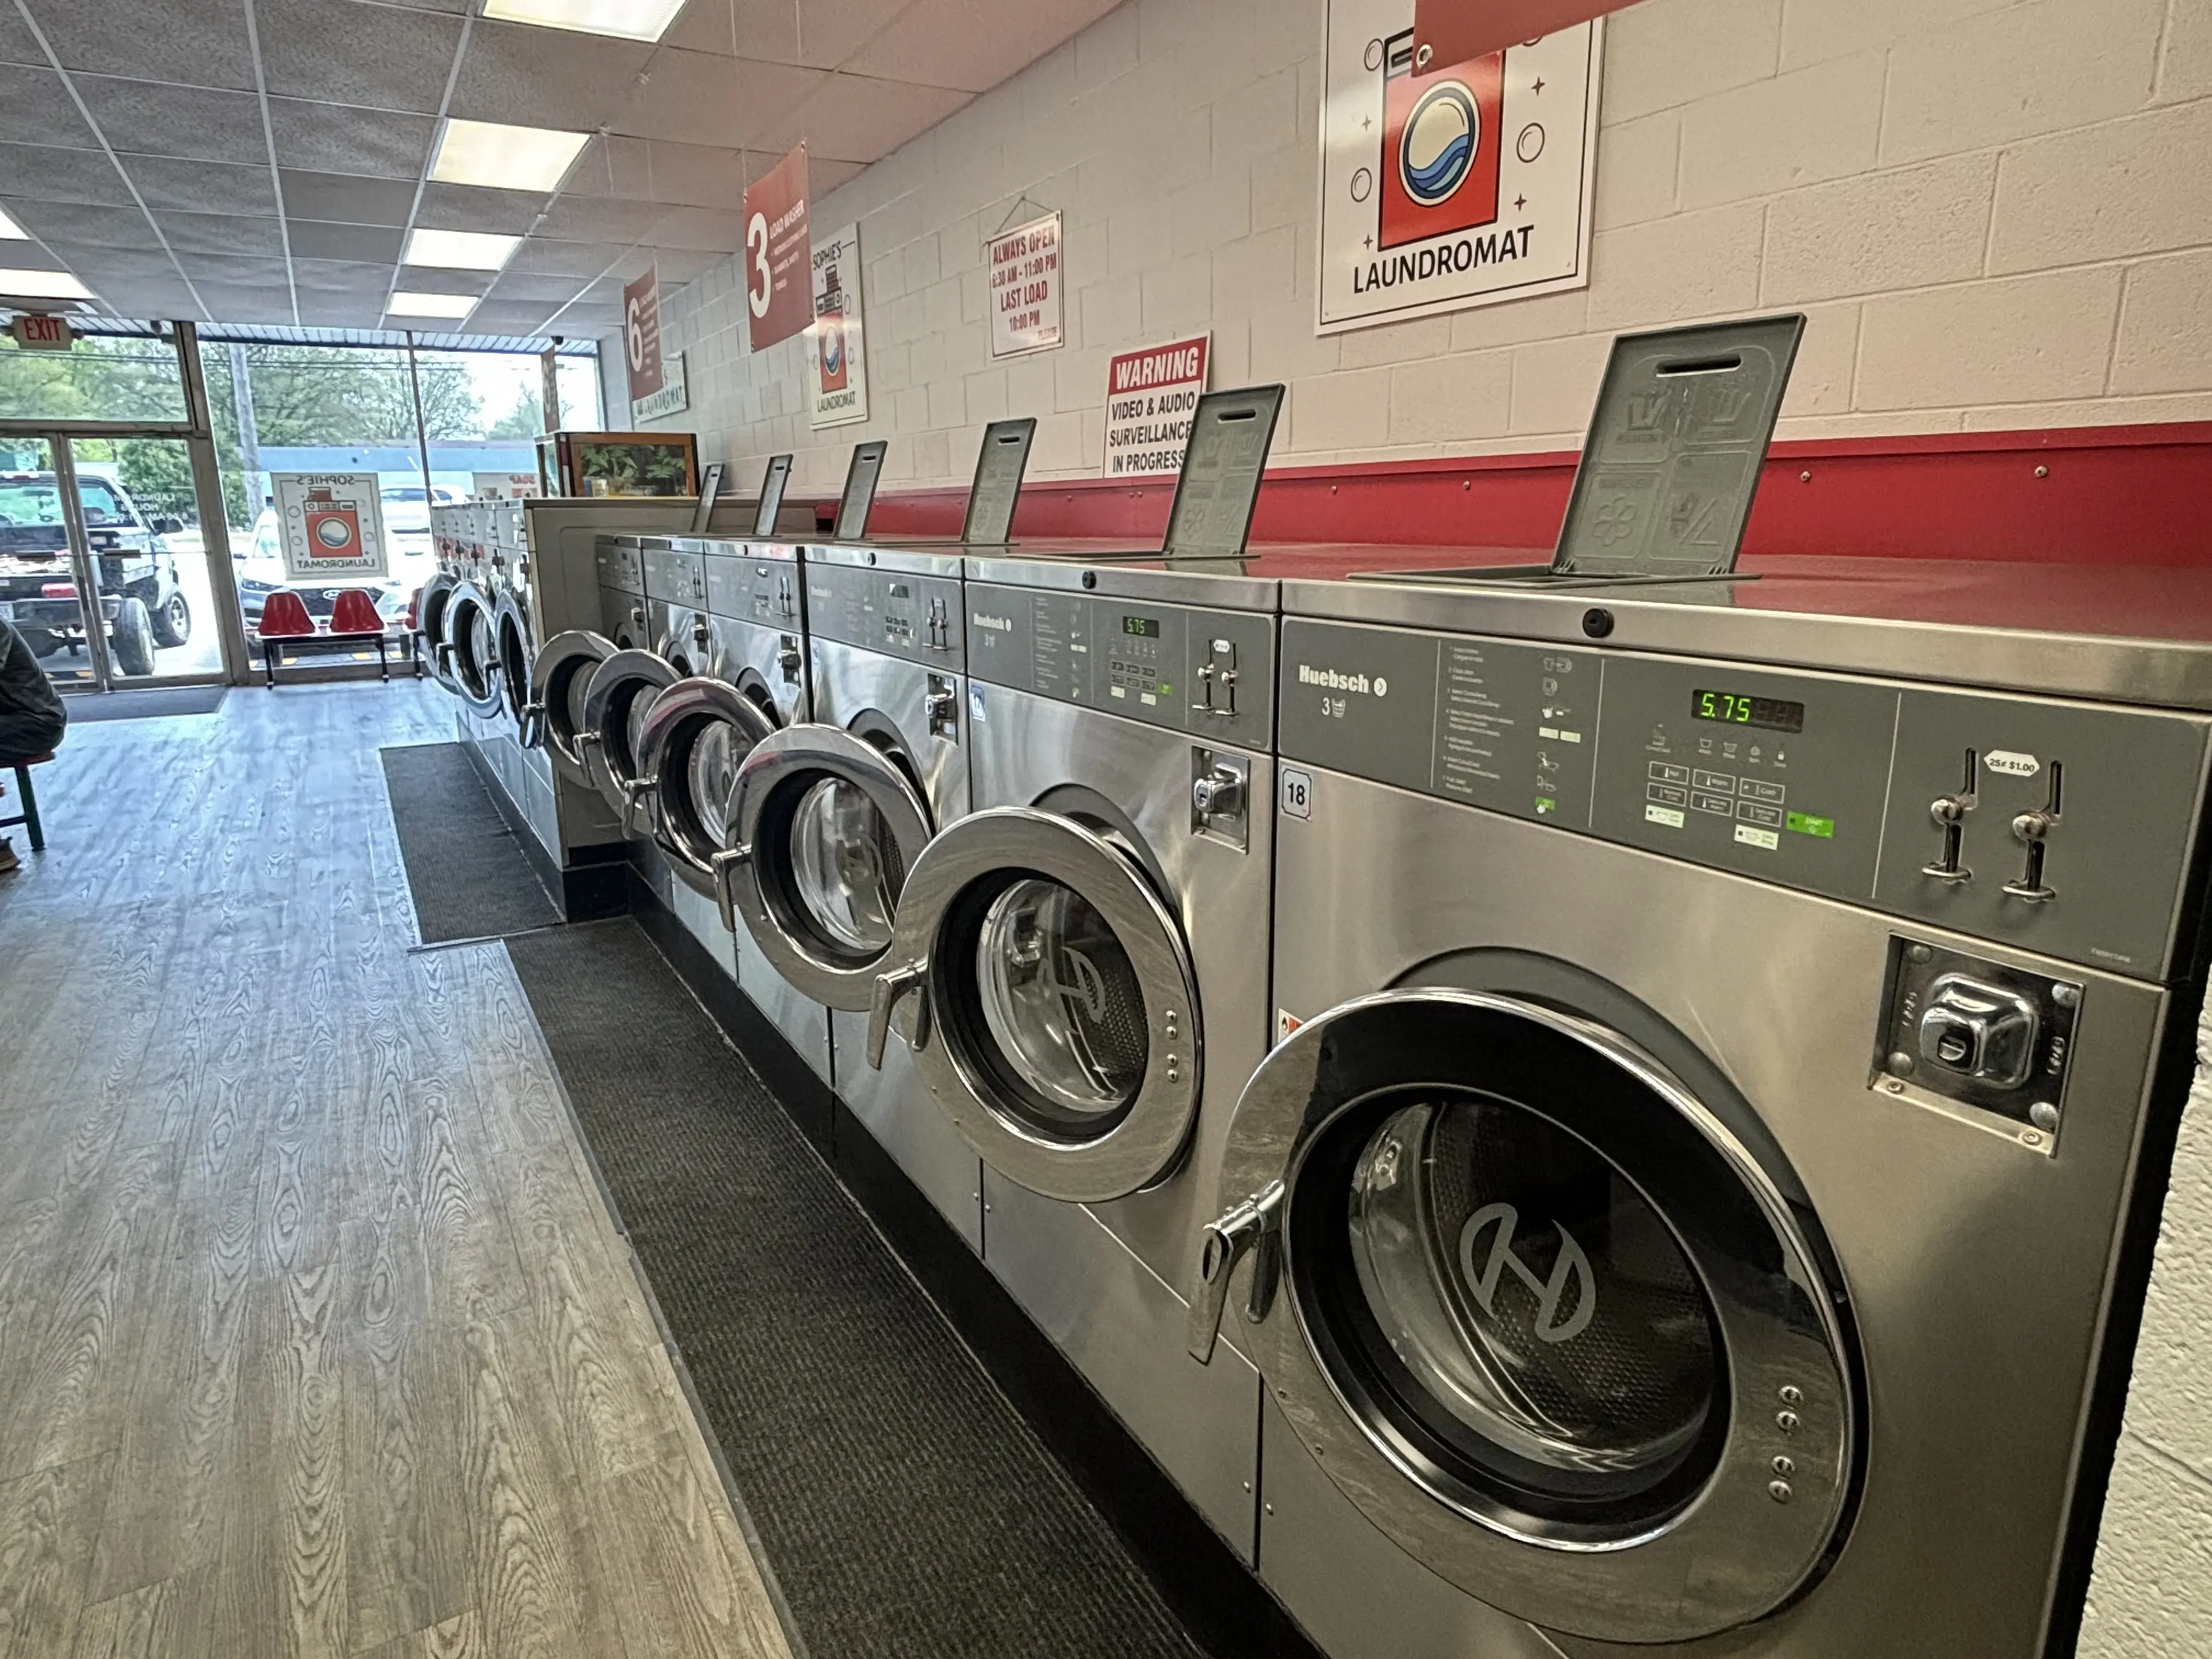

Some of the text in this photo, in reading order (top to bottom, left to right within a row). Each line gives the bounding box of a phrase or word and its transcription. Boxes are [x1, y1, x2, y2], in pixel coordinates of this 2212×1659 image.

[993, 224, 1055, 266] ALWAYS OPEN
[1353, 224, 1534, 294] LAUNDROMAT
[747, 212, 771, 319] 3
[1007, 265, 1017, 284] AM
[1046, 252, 1057, 272] PM
[1000, 280, 1048, 313] LAST LOAD
[24, 318, 61, 341] EXIT
[1029, 309, 1040, 328] PM
[628, 297, 643, 372] 6
[1116, 346, 1199, 390] WARNING
[1111, 391, 1195, 421] VIDEO & AUDIO
[1109, 420, 1192, 448] SURVEILLANCE
[1113, 449, 1186, 473] IN PROGRESS
[1299, 664, 1369, 693] Huebsch
[1321, 697, 1330, 715] 3
[1700, 693, 1751, 723] 5.75
[1288, 782, 1306, 805] 18
